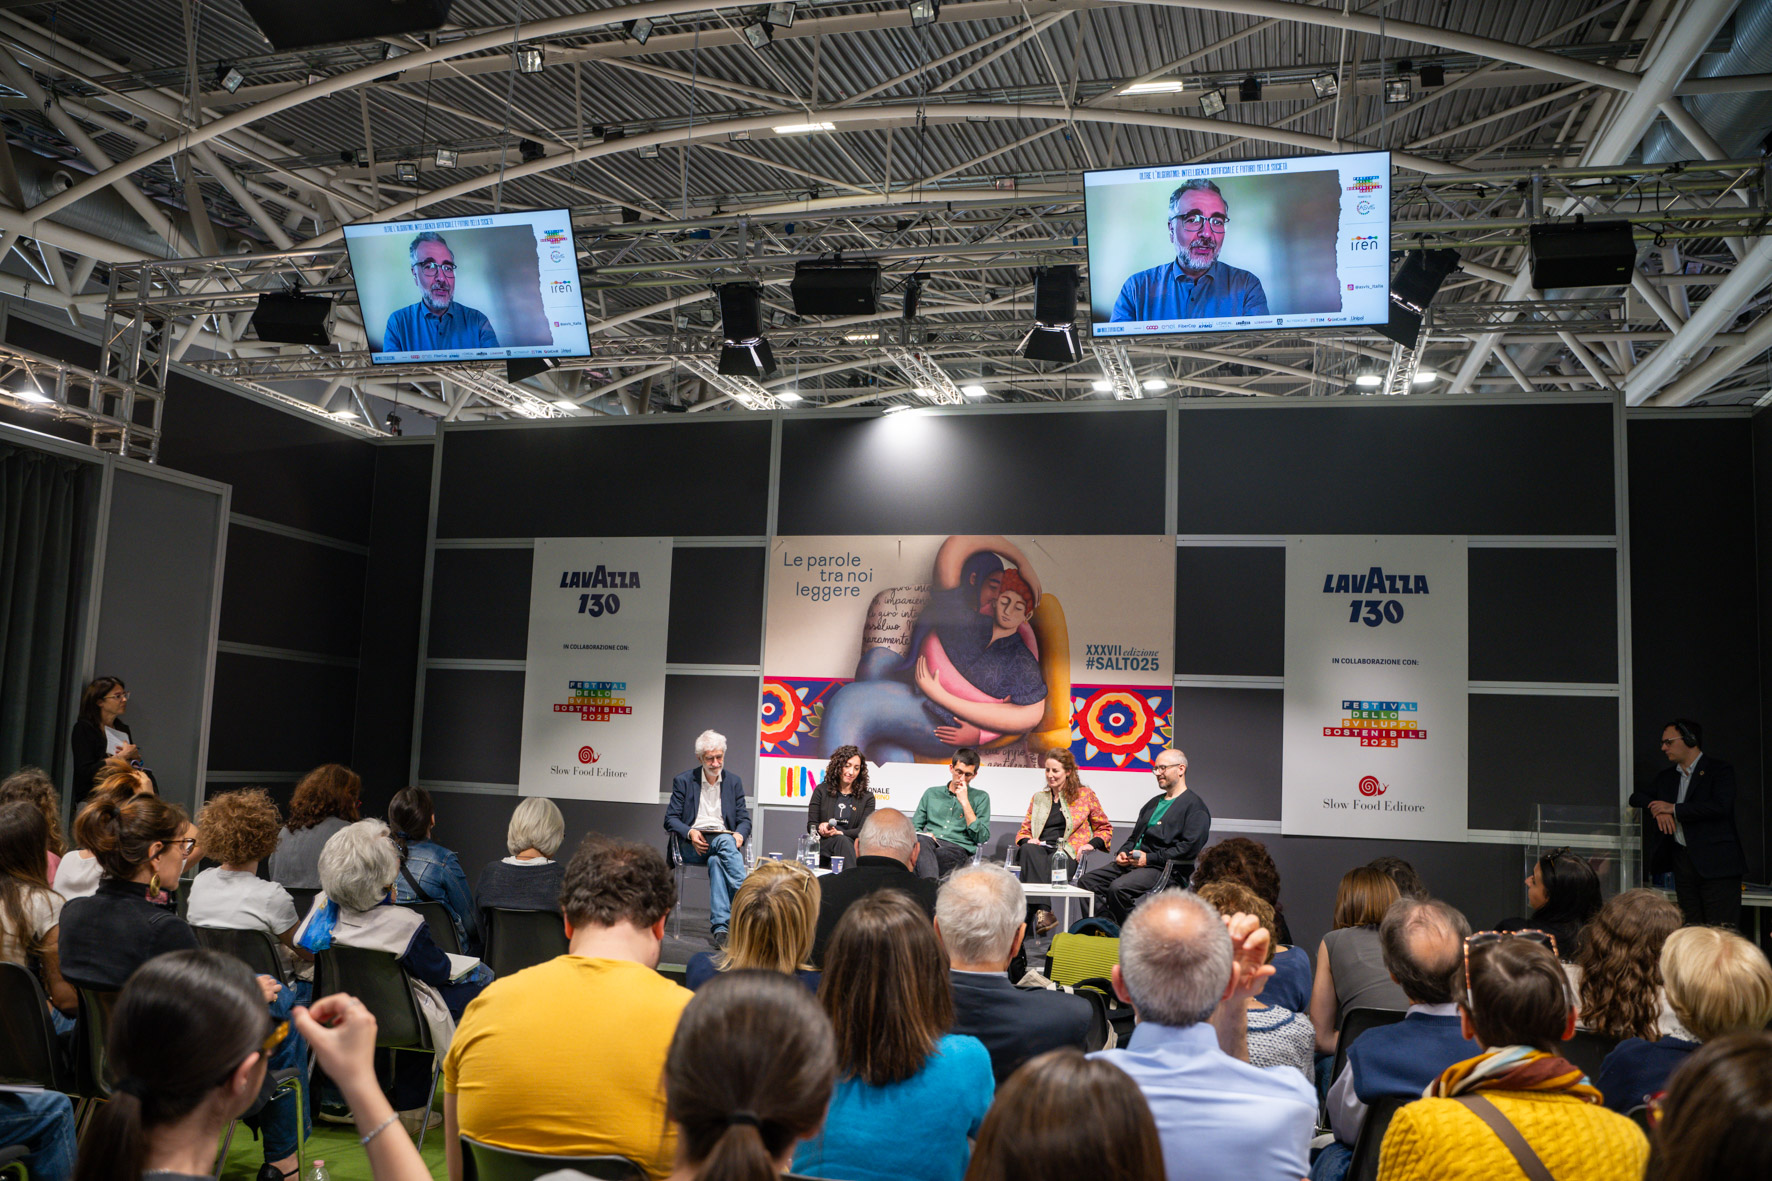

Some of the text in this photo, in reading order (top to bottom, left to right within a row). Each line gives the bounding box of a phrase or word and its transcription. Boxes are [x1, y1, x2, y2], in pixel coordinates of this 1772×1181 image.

[1351, 240, 1378, 251] iren
[550, 284, 572, 293] iren
[784, 551, 861, 571] Le parole
[559, 564, 641, 588] LAVAZZA
[820, 568, 873, 582] tra noi
[1322, 566, 1430, 594] LAVAZZA
[796, 581, 860, 601] leggere
[578, 593, 620, 617] 130
[1349, 599, 1404, 627] 130
[1086, 644, 1159, 657] XXXVII edizione
[1086, 656, 1160, 671] #SALTO25
[569, 681, 626, 690] FESTIVAL
[569, 698, 625, 706] SVILUPPO
[1343, 701, 1416, 711] FESTIVAL
[554, 705, 631, 714] SOSTENIBILE
[1352, 711, 1398, 719] DELLO
[582, 713, 609, 721] 2025
[1343, 719, 1417, 729] SVILUPPO
[1324, 728, 1426, 739] SOSTENIBILE
[1361, 738, 1397, 747] 2025
[550, 765, 628, 778] Slow Food Editore
[1323, 798, 1425, 812] Slow Food Editore
